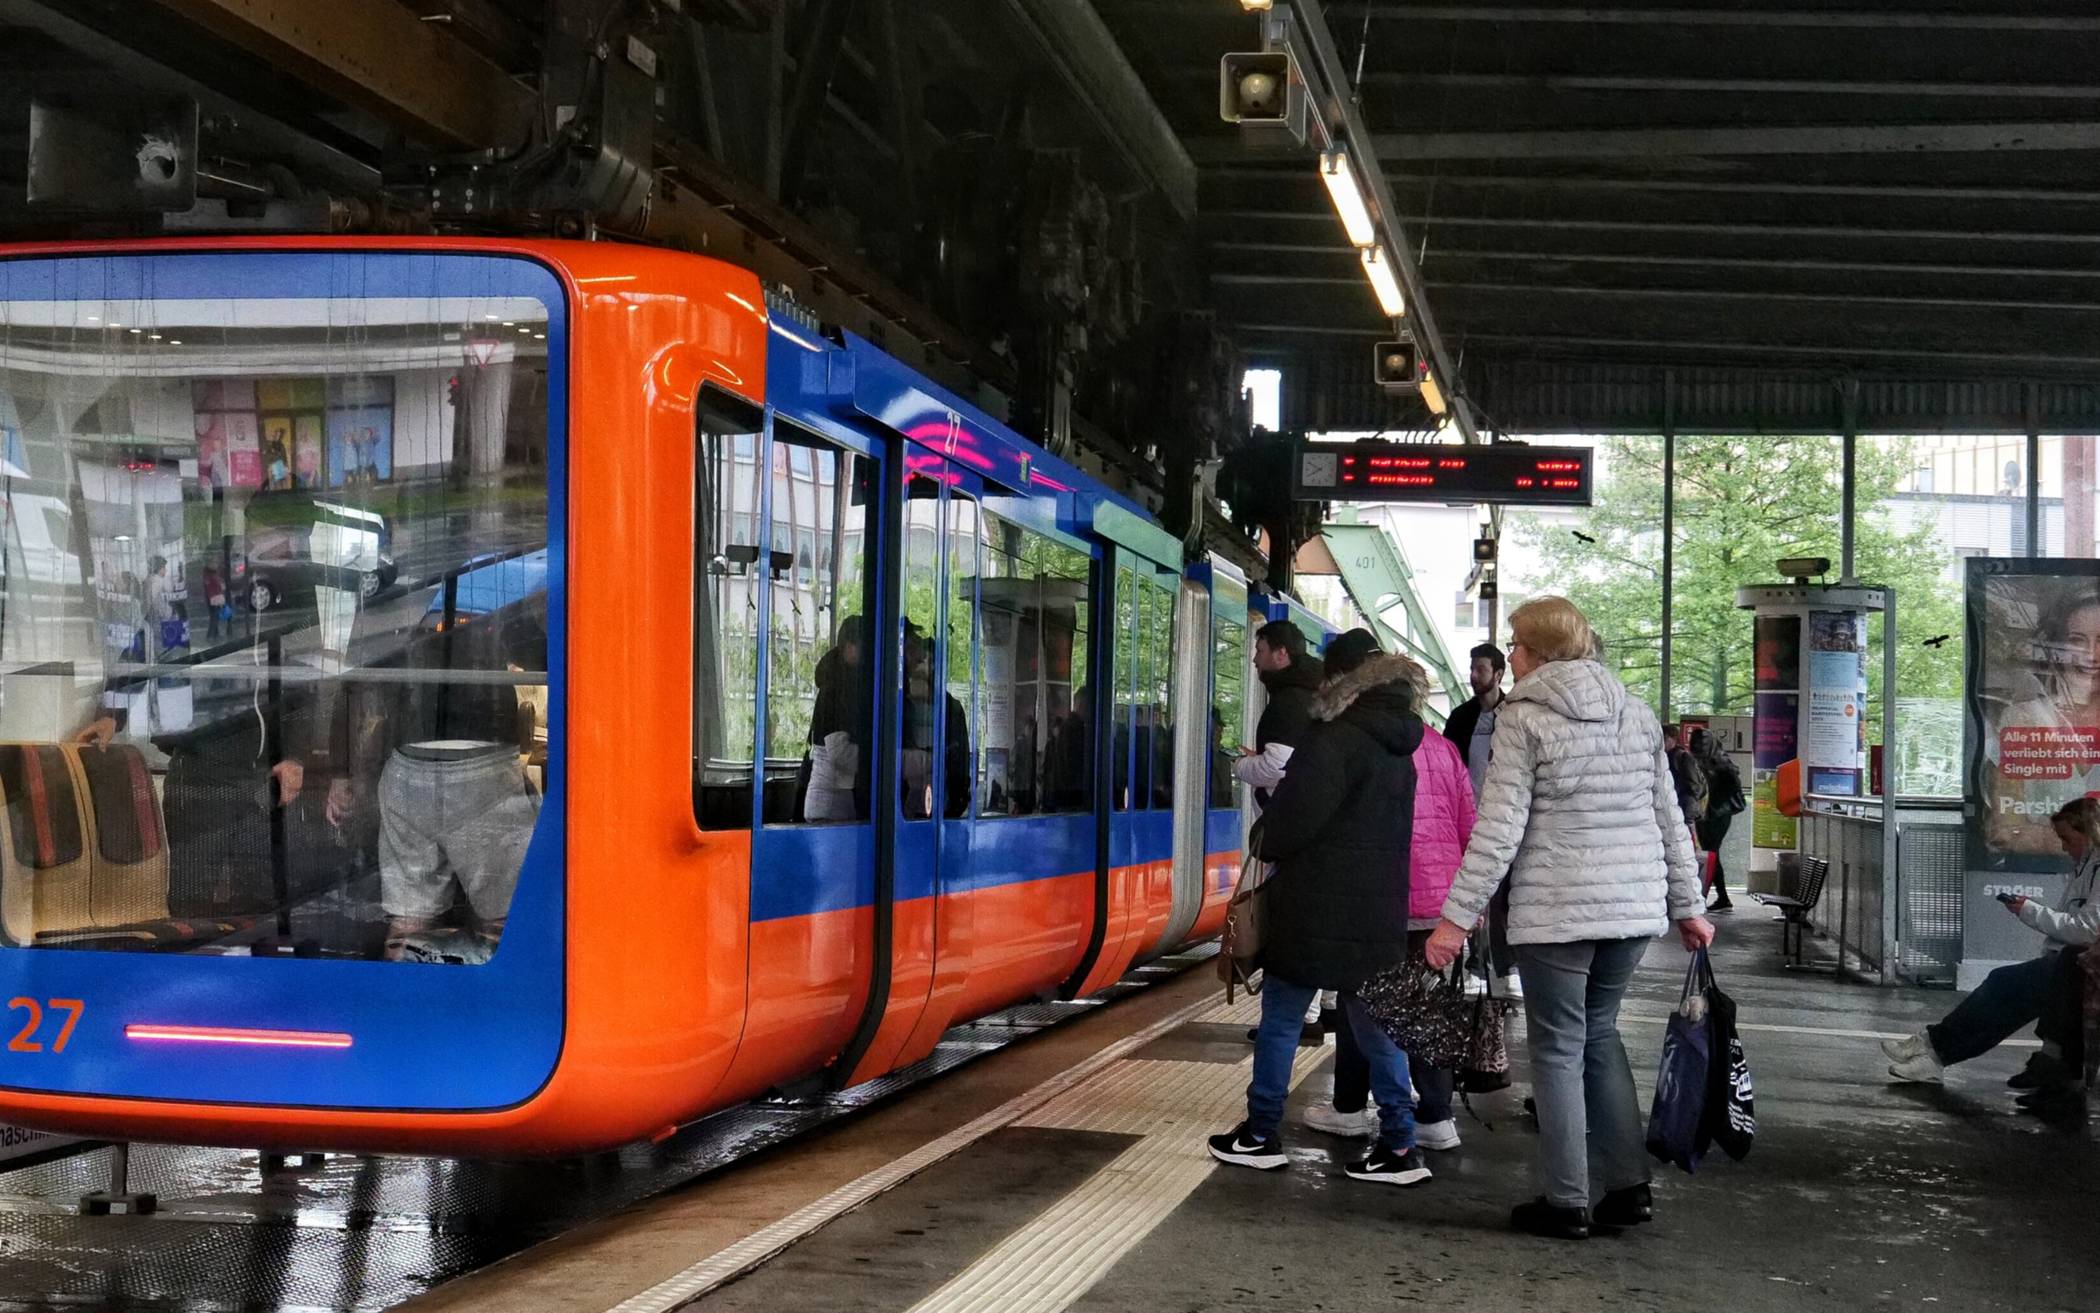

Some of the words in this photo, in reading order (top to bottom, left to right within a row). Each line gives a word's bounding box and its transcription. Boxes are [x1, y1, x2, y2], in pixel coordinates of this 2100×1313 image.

[945, 411, 960, 455] 27
[2004, 732, 2027, 742] Alle
[2031, 732, 2041, 742] 11
[2045, 732, 2094, 742] Minuten
[2004, 748, 2052, 758] verliebt
[2055, 748, 2078, 758] sich
[2004, 764, 2043, 776] Single
[2046, 764, 2067, 774] mit
[8, 997, 84, 1053] 27
